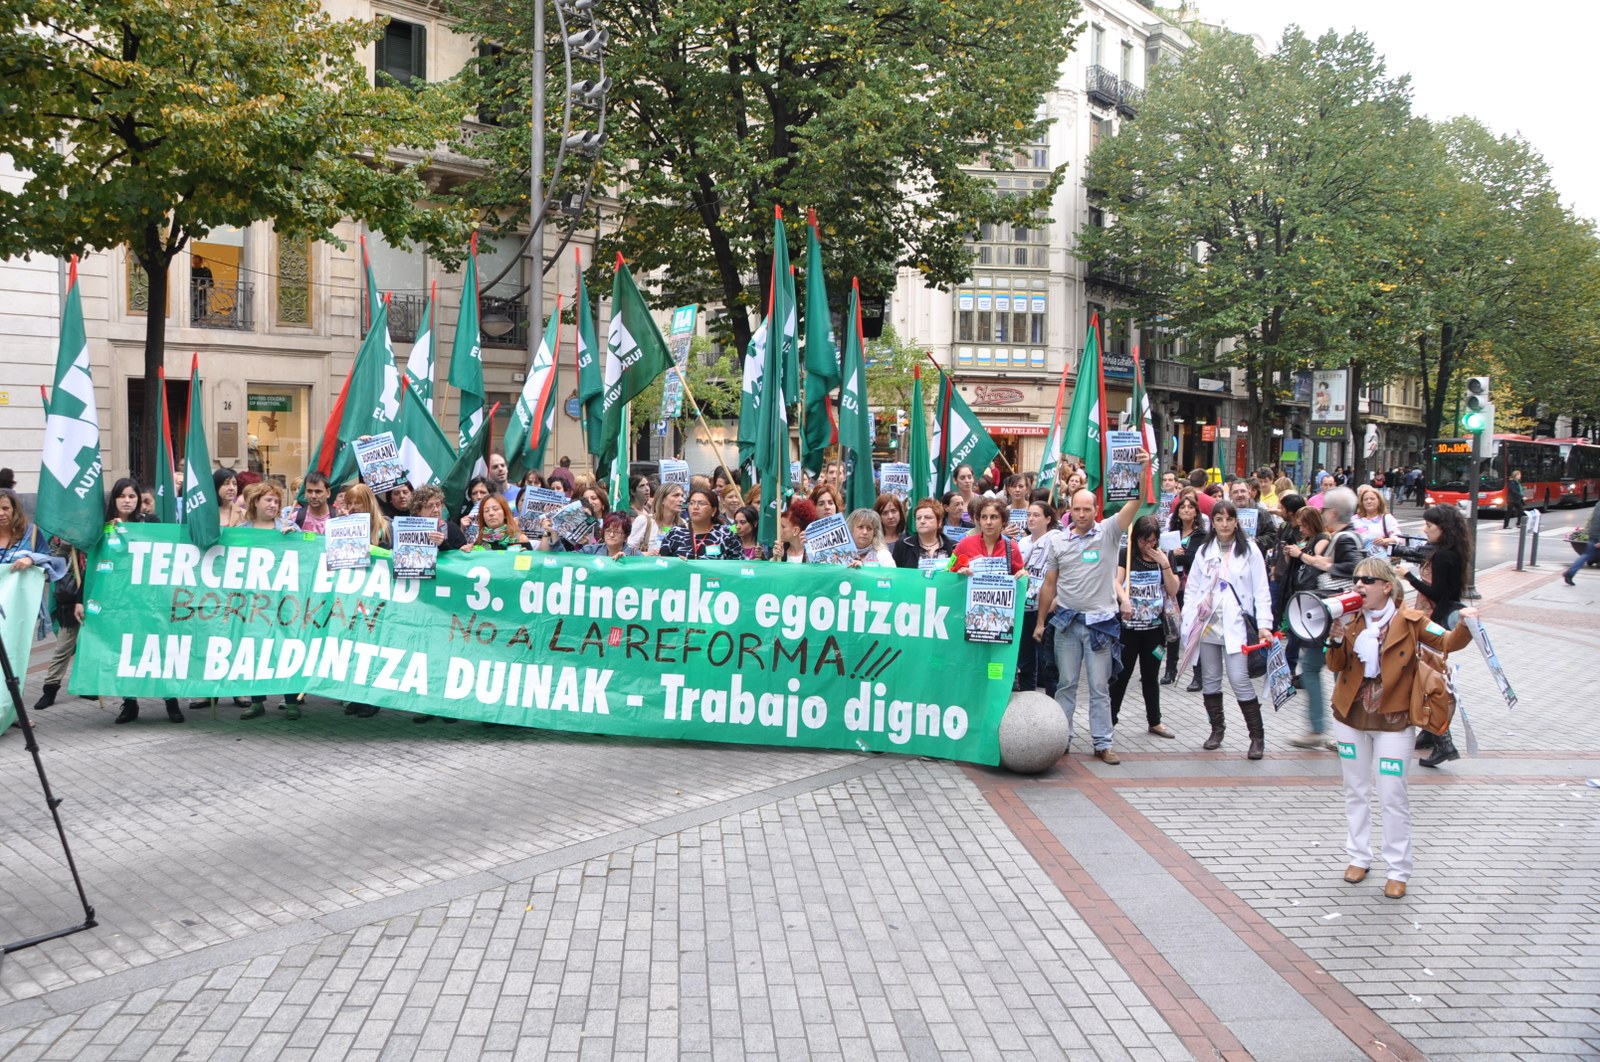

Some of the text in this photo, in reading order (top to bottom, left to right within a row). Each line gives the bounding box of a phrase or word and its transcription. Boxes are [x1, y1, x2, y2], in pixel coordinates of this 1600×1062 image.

[224, 401, 232, 410] 26
[1316, 427, 1344, 436] 12:04
[361, 443, 396, 464] BORROKAN!
[1438, 443, 1448, 452] 10
[331, 524, 366, 538] BORROKAN!
[809, 527, 848, 551] BORROKAN!
[1083, 552, 1097, 560] ELA
[128, 541, 300, 593] TERCERA
[467, 566, 506, 614] 3.
[519, 566, 740, 625] adinerako
[756, 578, 950, 641] egoitzak
[972, 590, 1012, 607] BORROKAN!
[171, 588, 386, 634] BORROKAN
[506, 626, 533, 651] A
[549, 618, 605, 658] LA
[117, 634, 969, 745] LAN BALDINTZA DUINAK - Trabajo digno
[1381, 761, 1401, 772] ELA
